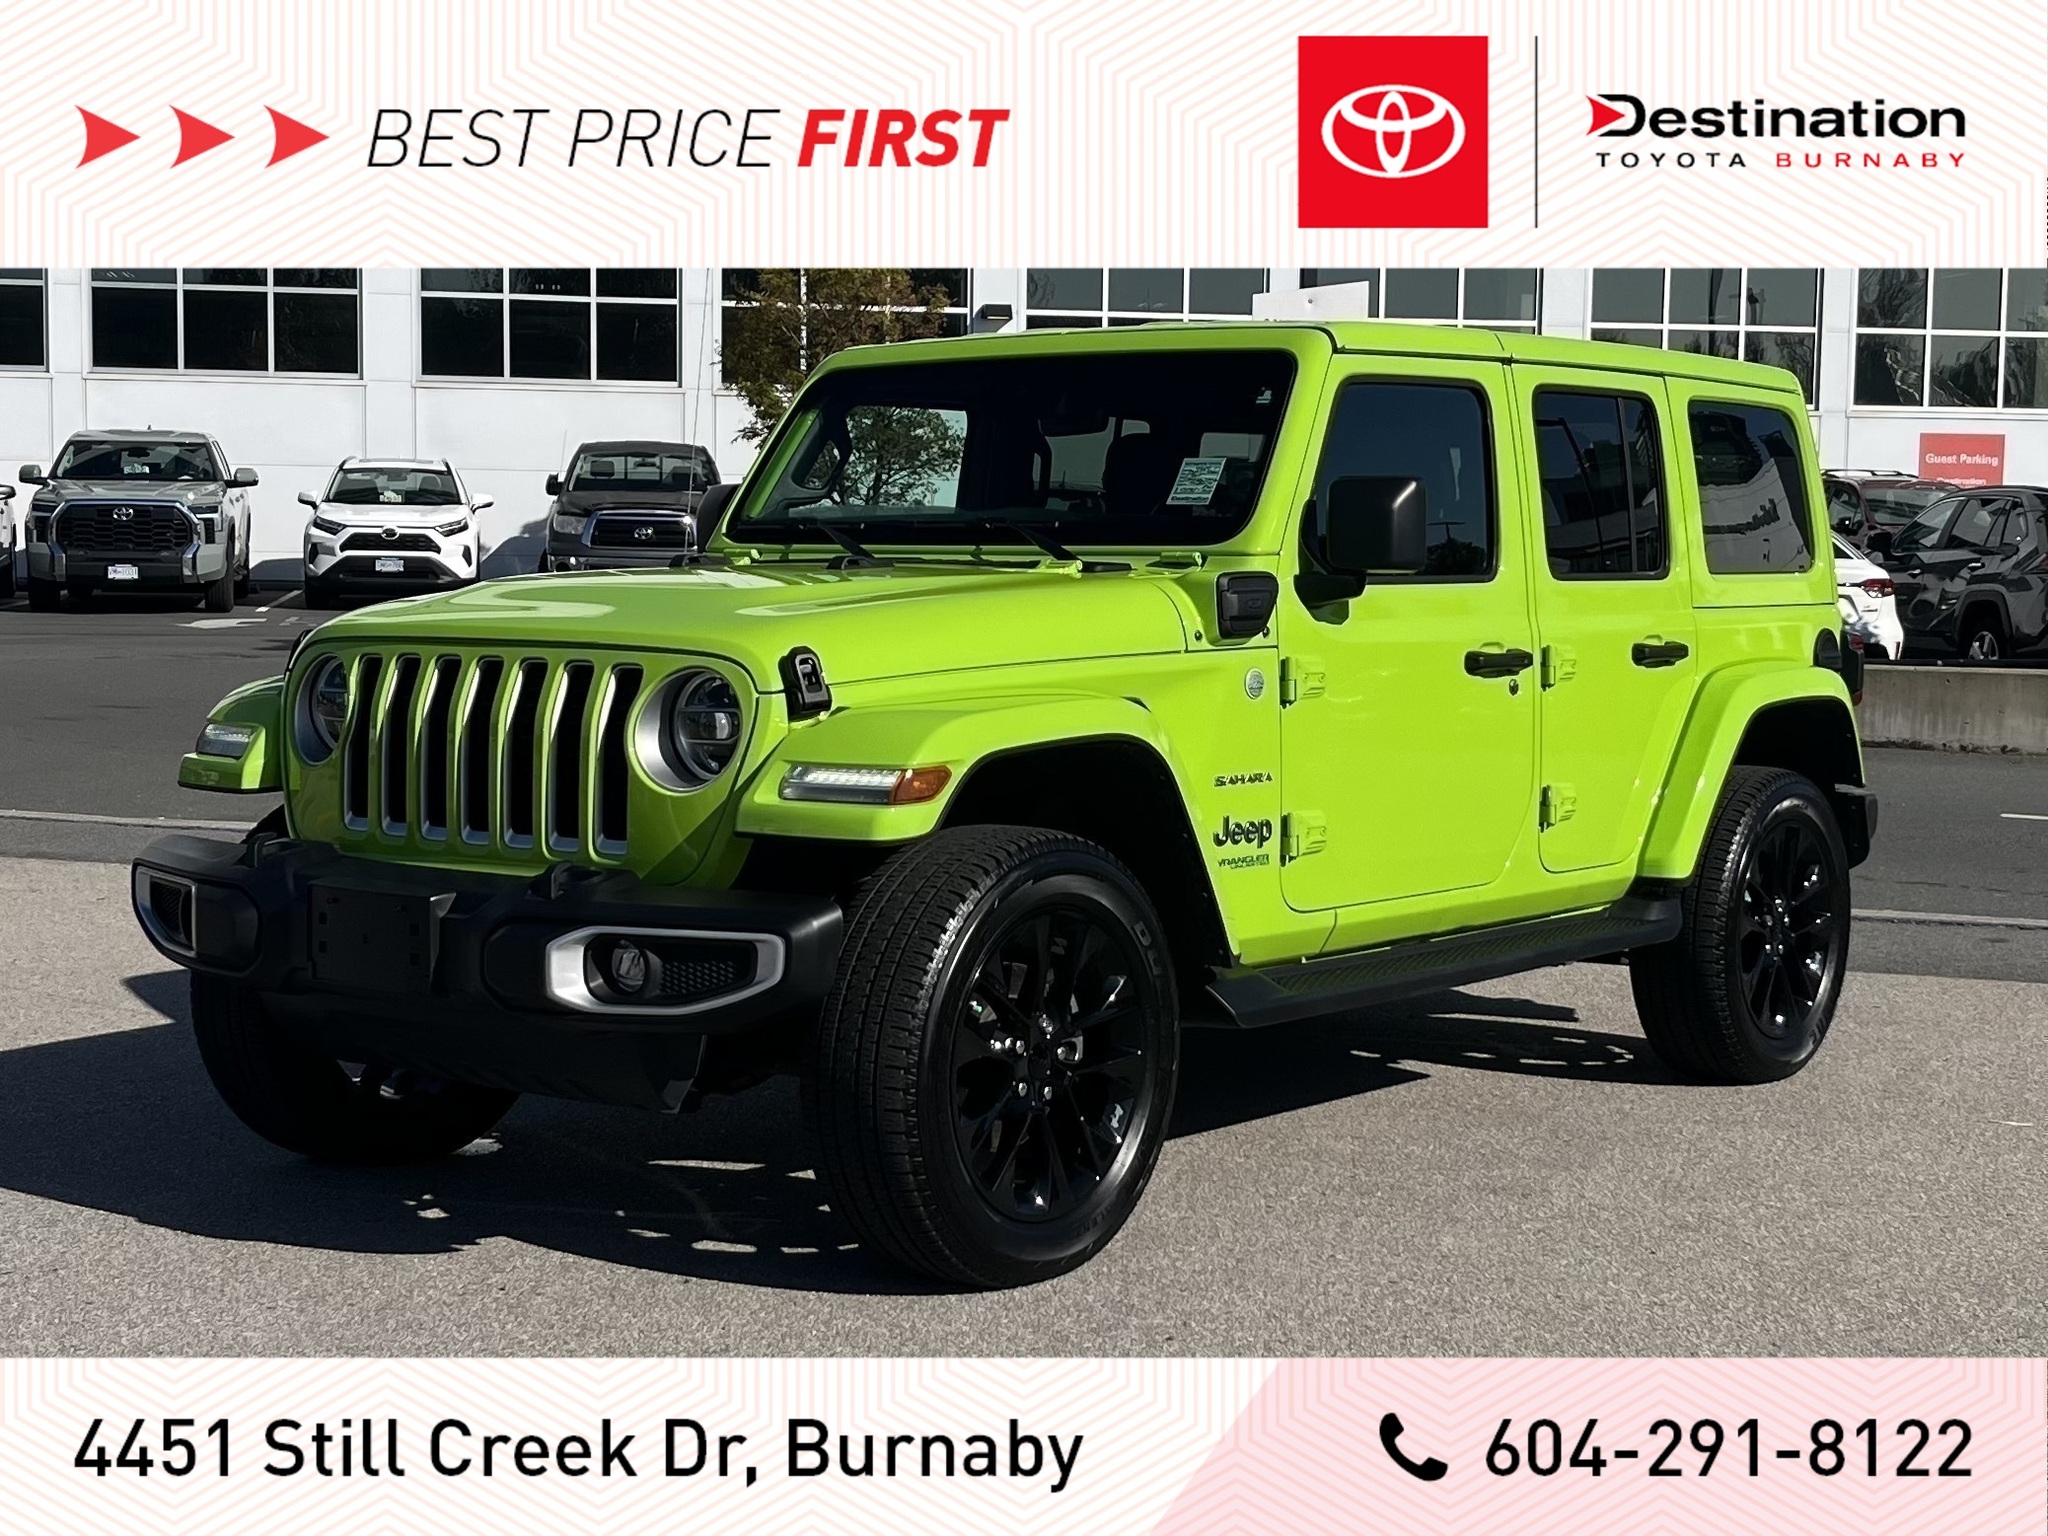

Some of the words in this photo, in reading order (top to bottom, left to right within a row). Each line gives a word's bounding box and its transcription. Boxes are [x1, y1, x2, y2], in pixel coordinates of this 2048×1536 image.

[1925, 453, 1957, 464] Guest
[1960, 453, 1999, 467] Parking
[1214, 772, 1273, 787] SAHARA
[1213, 815, 1273, 849] Jeep
